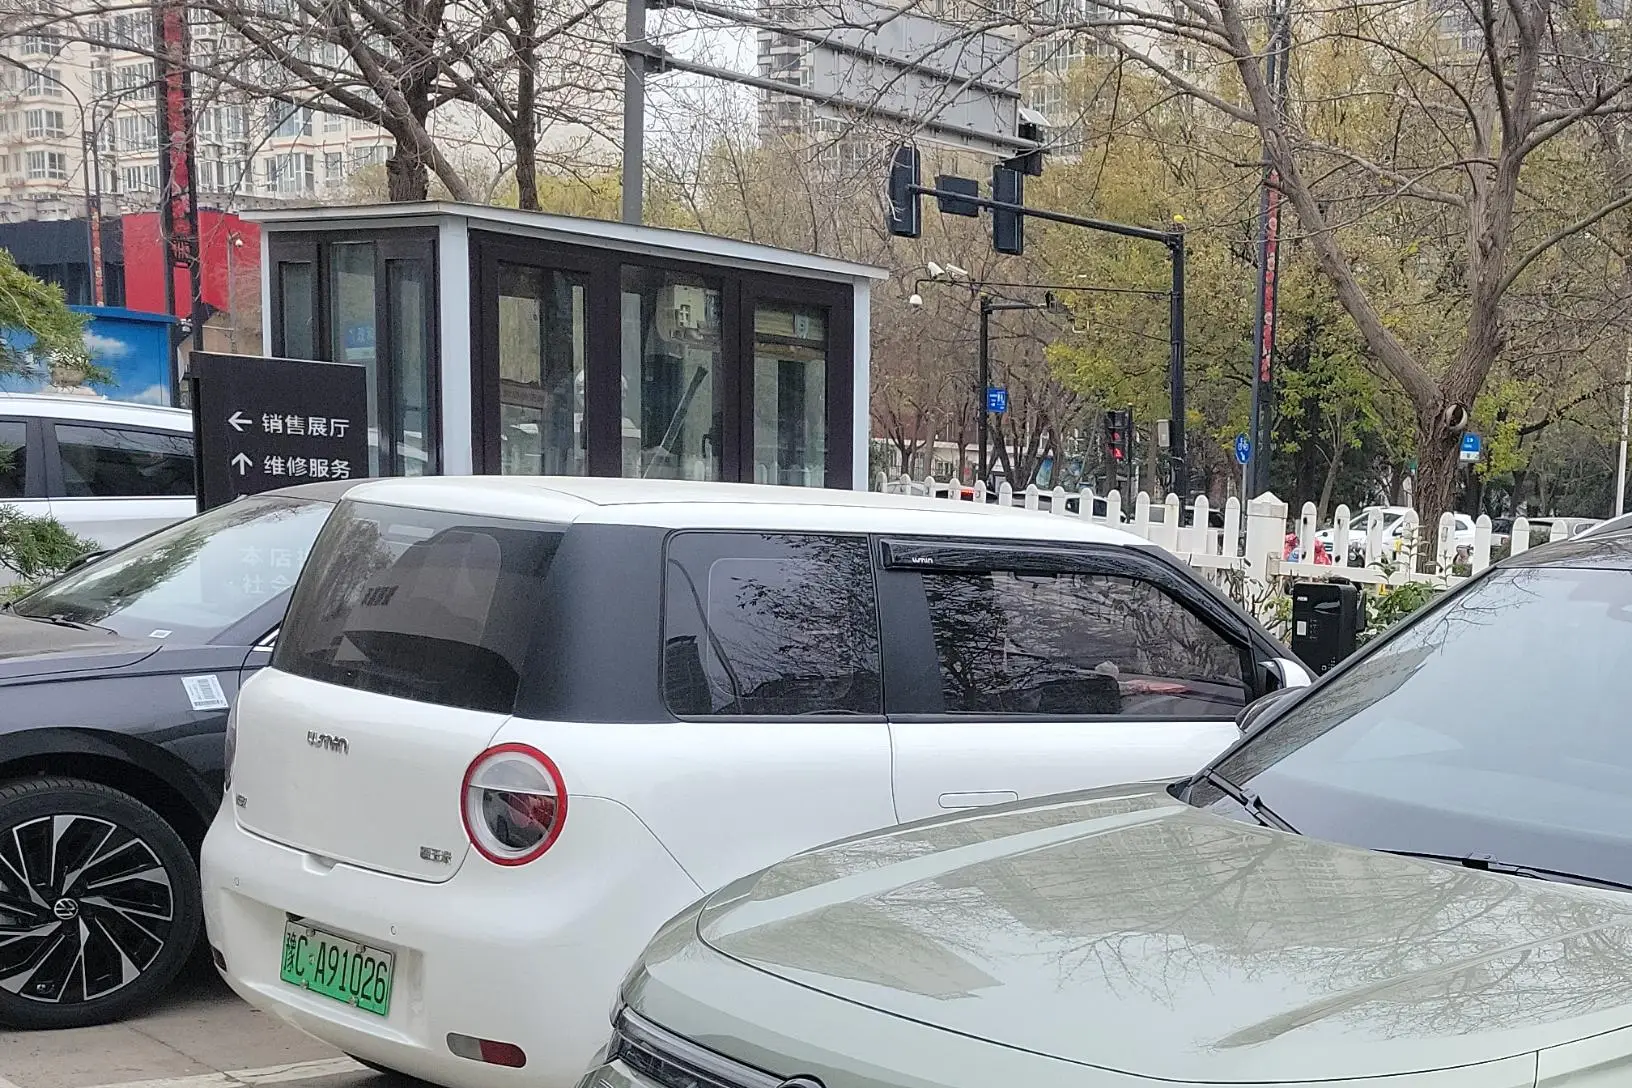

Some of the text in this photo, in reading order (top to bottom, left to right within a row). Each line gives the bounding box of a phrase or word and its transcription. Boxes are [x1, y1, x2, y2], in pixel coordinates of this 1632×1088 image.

[262, 413, 350, 438] 销售展厅
[263, 455, 352, 479] 维修服务
